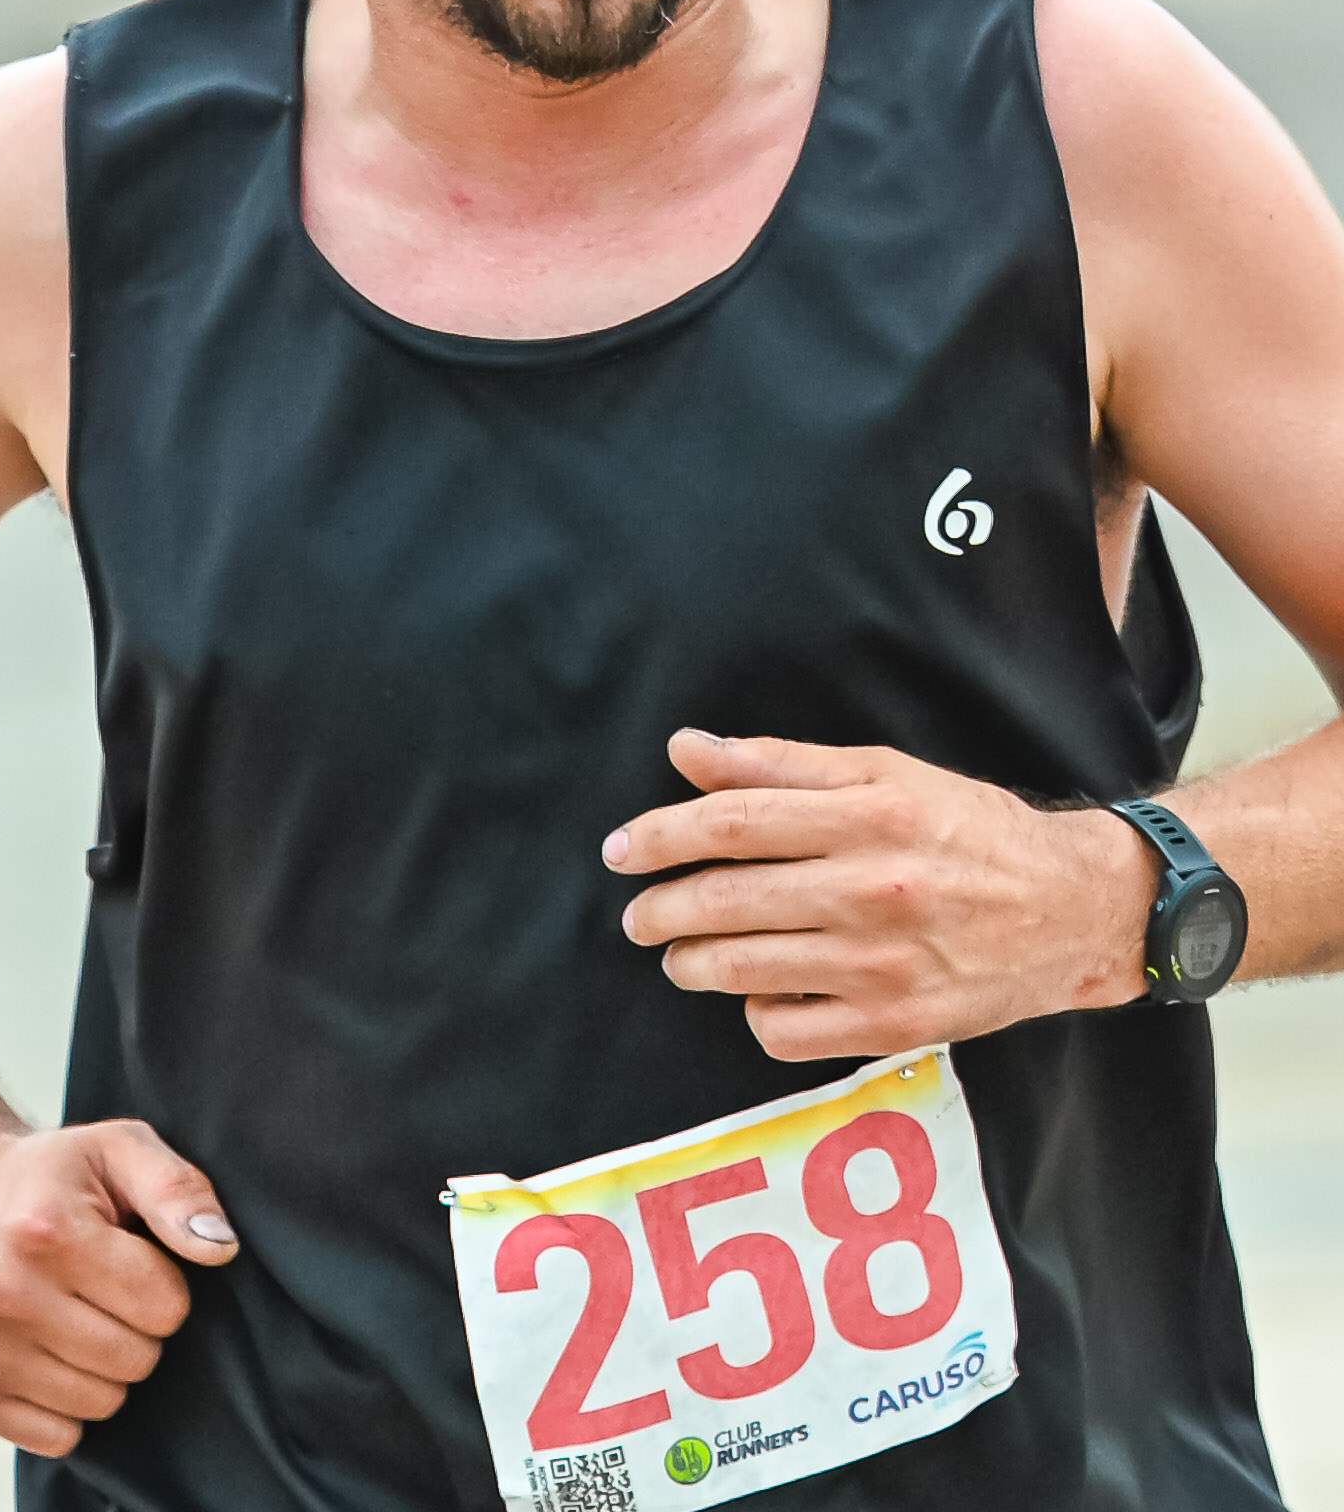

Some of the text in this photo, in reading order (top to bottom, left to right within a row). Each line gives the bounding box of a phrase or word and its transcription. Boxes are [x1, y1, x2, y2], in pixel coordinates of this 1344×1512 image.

[494, 1109, 963, 1452] 258
[848, 1352, 984, 1423] CARUSO
[715, 1421, 762, 1448] CLUB
